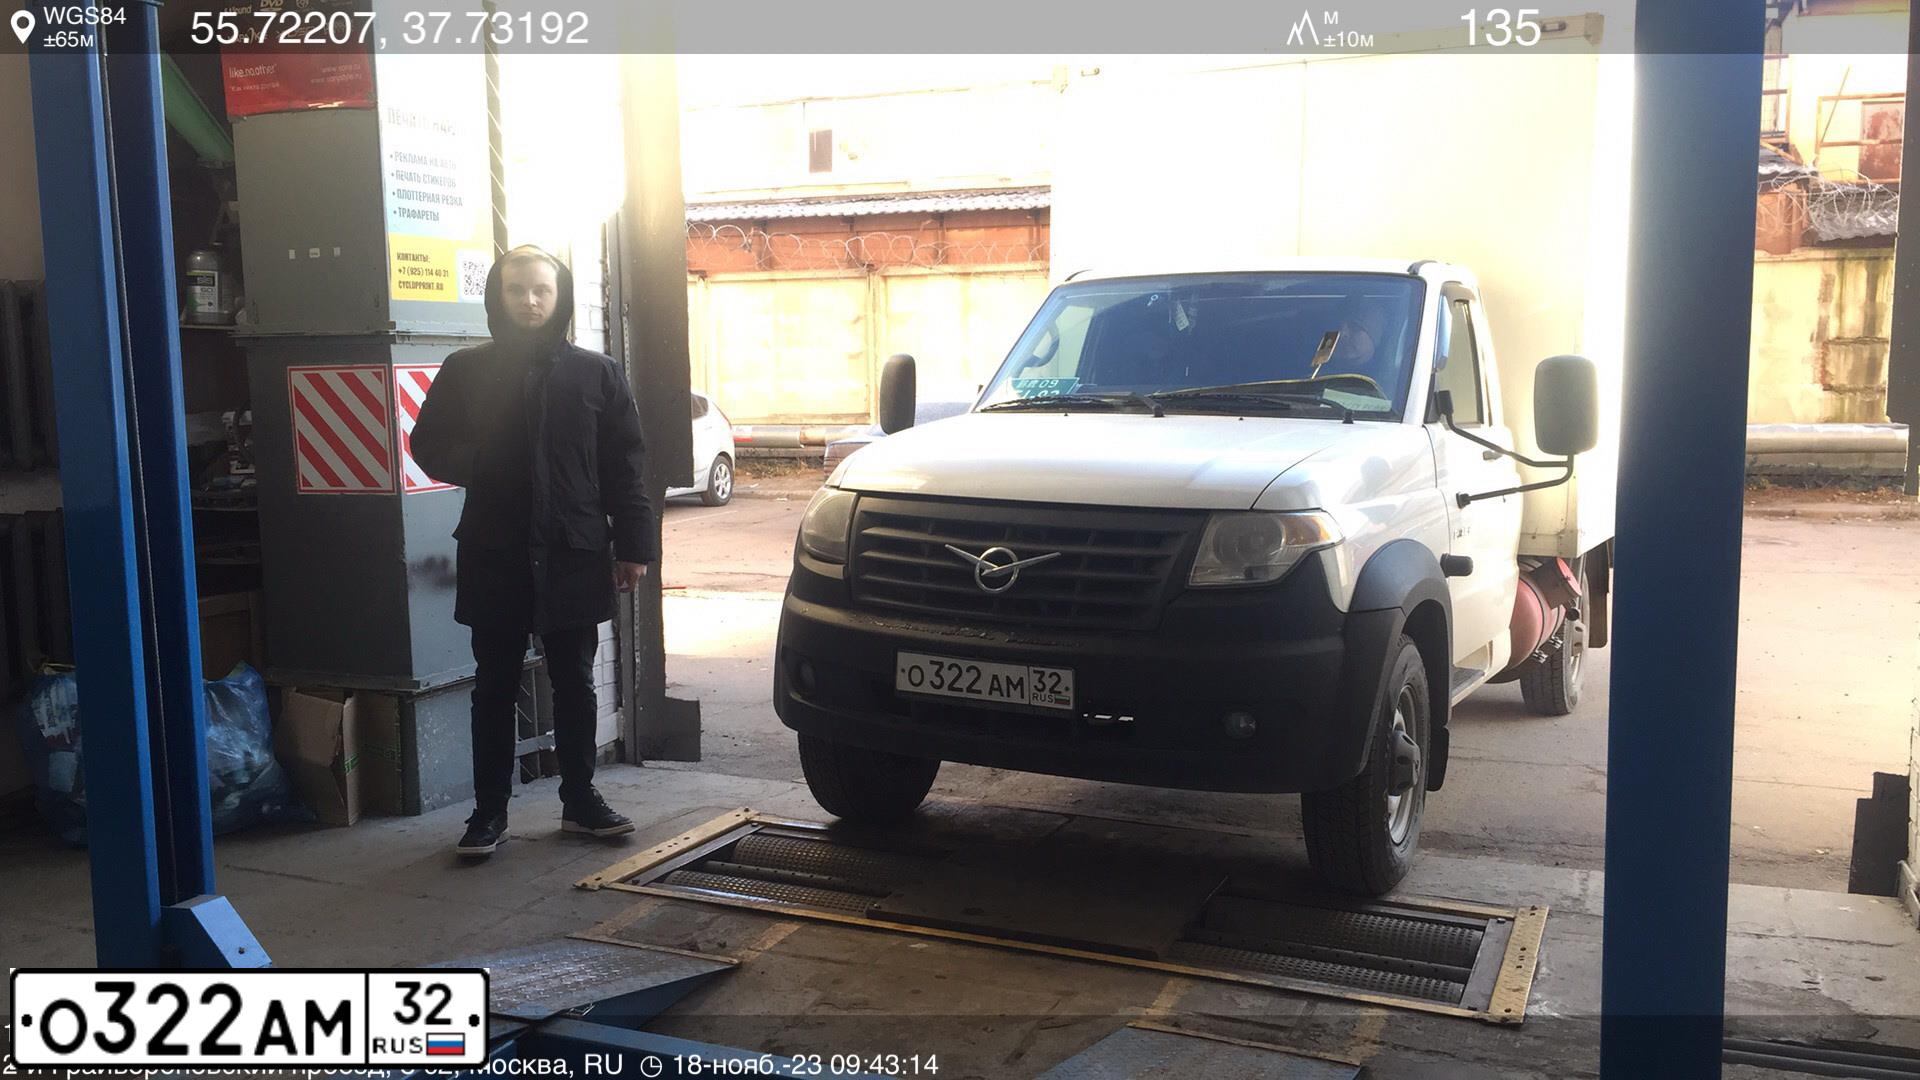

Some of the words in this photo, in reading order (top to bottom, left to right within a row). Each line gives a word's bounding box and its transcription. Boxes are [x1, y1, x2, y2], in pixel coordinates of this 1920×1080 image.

[396, 170, 421, 184] ПЕЧАТЬ
[398, 207, 439, 221] ТРАФАРЕТЫ
[1033, 670, 1062, 694] 32
[1032, 693, 1054, 703] RUS
